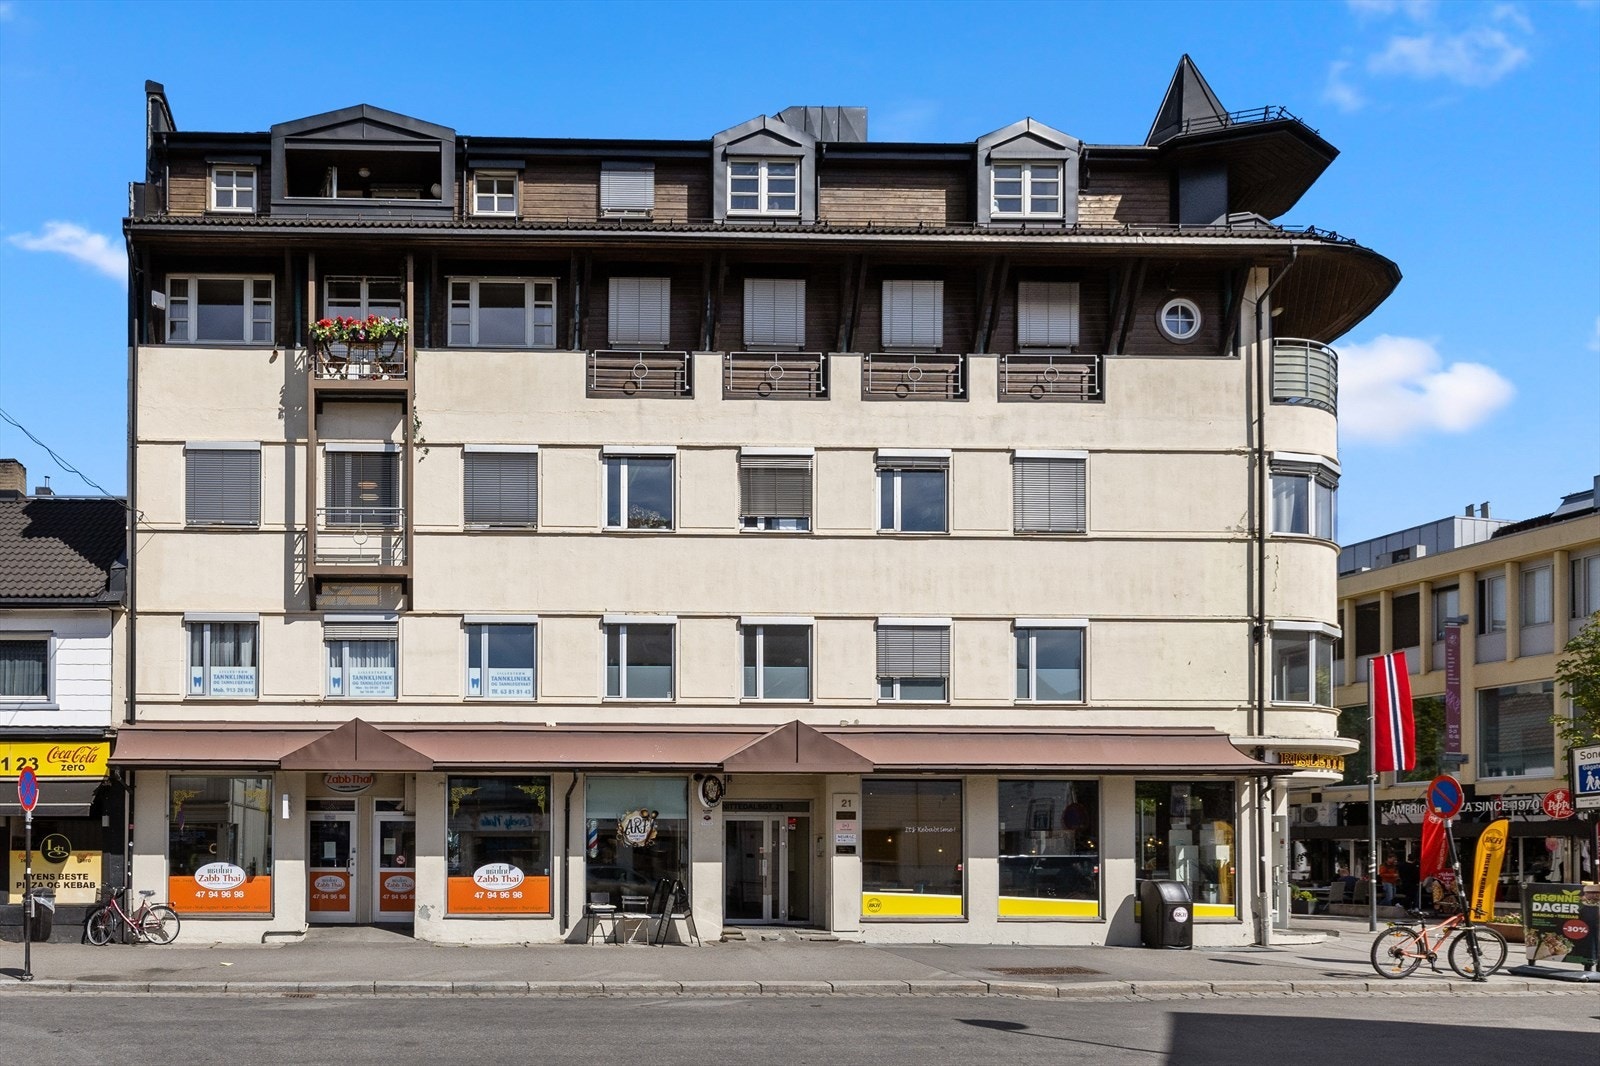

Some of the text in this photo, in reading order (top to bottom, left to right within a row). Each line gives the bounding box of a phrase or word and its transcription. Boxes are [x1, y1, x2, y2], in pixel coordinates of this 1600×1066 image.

[61, 763, 85, 771] zero
[326, 774, 372, 784] Zabb Thai
[841, 799, 852, 808] 21
[1389, 804, 1426, 815] AMERIC
[1475, 801, 1508, 812] SINCE
[1513, 800, 1540, 811] 1970
[198, 874, 220, 882] Zabb
[222, 874, 241, 882] Thai
[477, 874, 499, 882] Zabb
[501, 874, 519, 882] Thai
[16, 881, 96, 889] PIZA OG KEBAB
[195, 890, 244, 898] 47 94 96 98
[474, 891, 523, 899] 47 94 96 98
[1532, 893, 1580, 903] GRØNNE
[1474, 899, 1483, 919] HOE
[1532, 902, 1580, 914] DAGER
[1563, 925, 1588, 933] -30%
